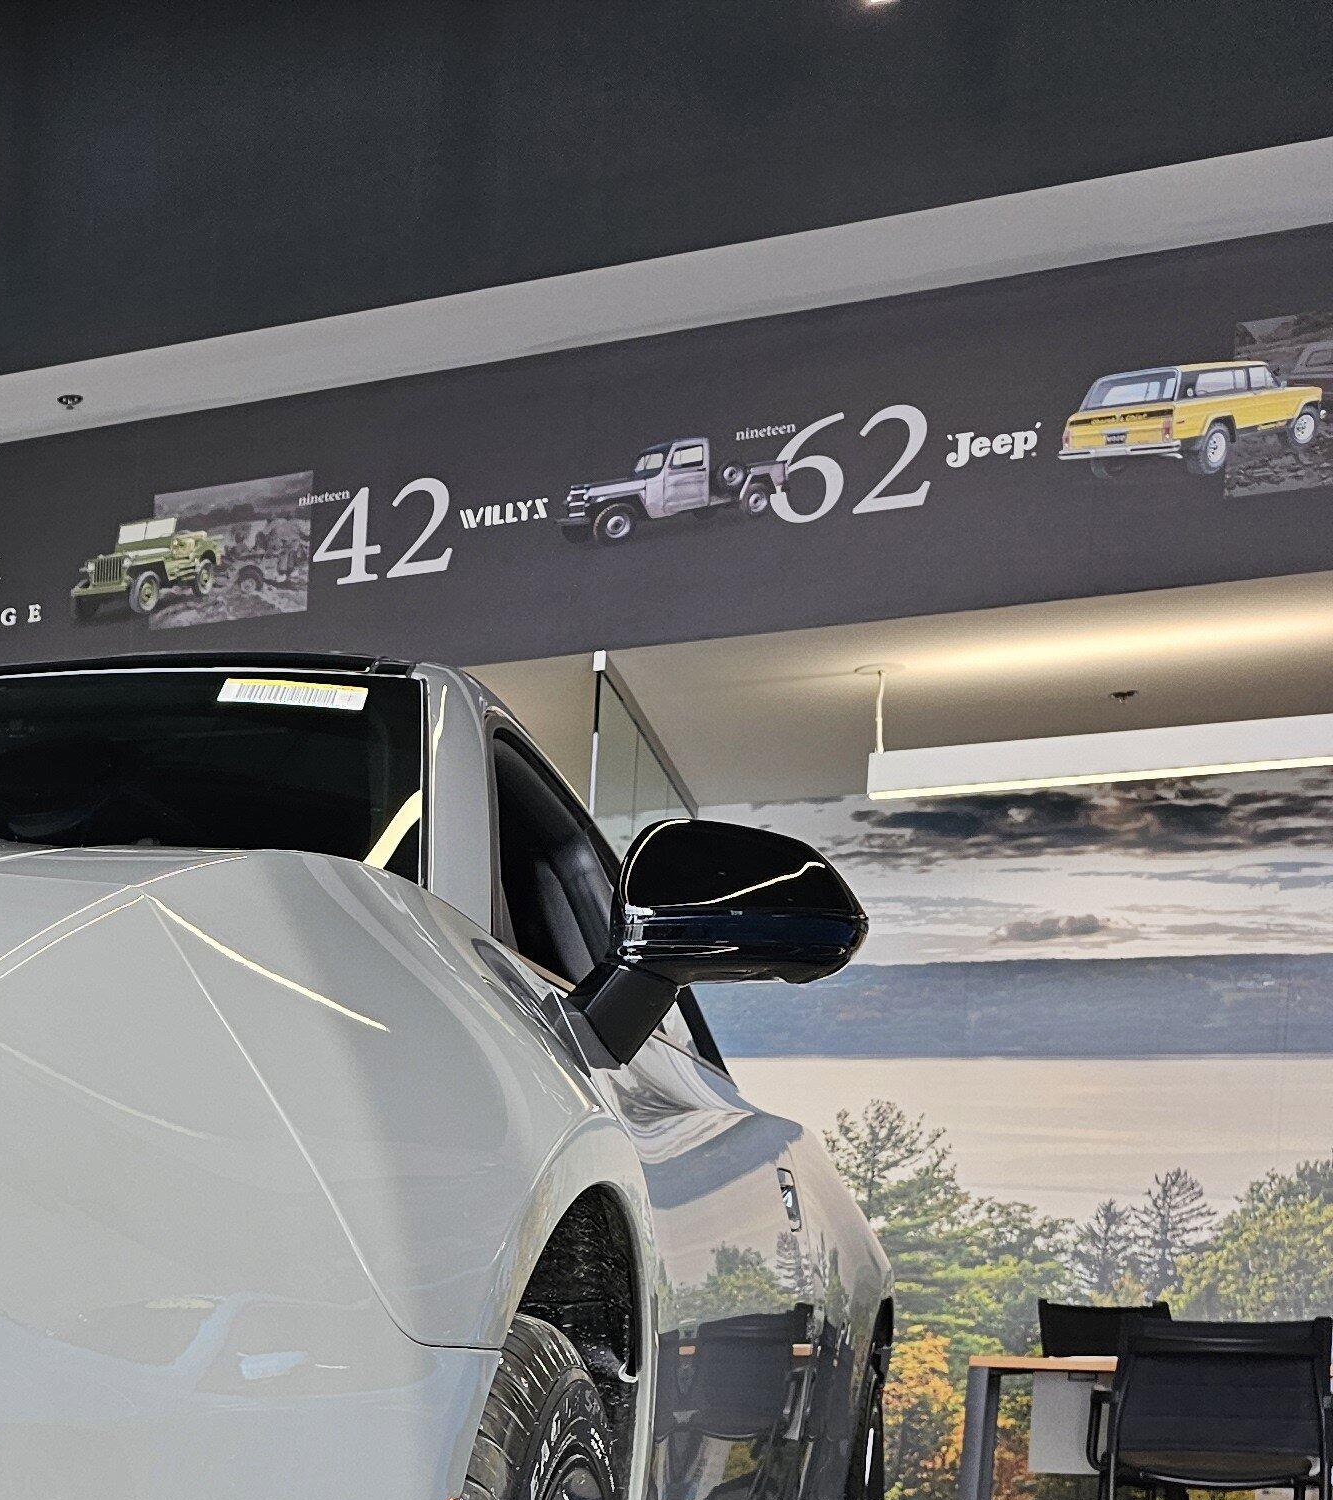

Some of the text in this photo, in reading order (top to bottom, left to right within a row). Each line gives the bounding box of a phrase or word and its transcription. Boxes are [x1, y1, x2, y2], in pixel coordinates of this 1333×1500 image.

[735, 423, 796, 441] nineteen
[769, 404, 931, 523] 62
[297, 489, 351, 507] nineteen
[459, 497, 549, 529] WILLYS
[312, 477, 453, 585] 42
